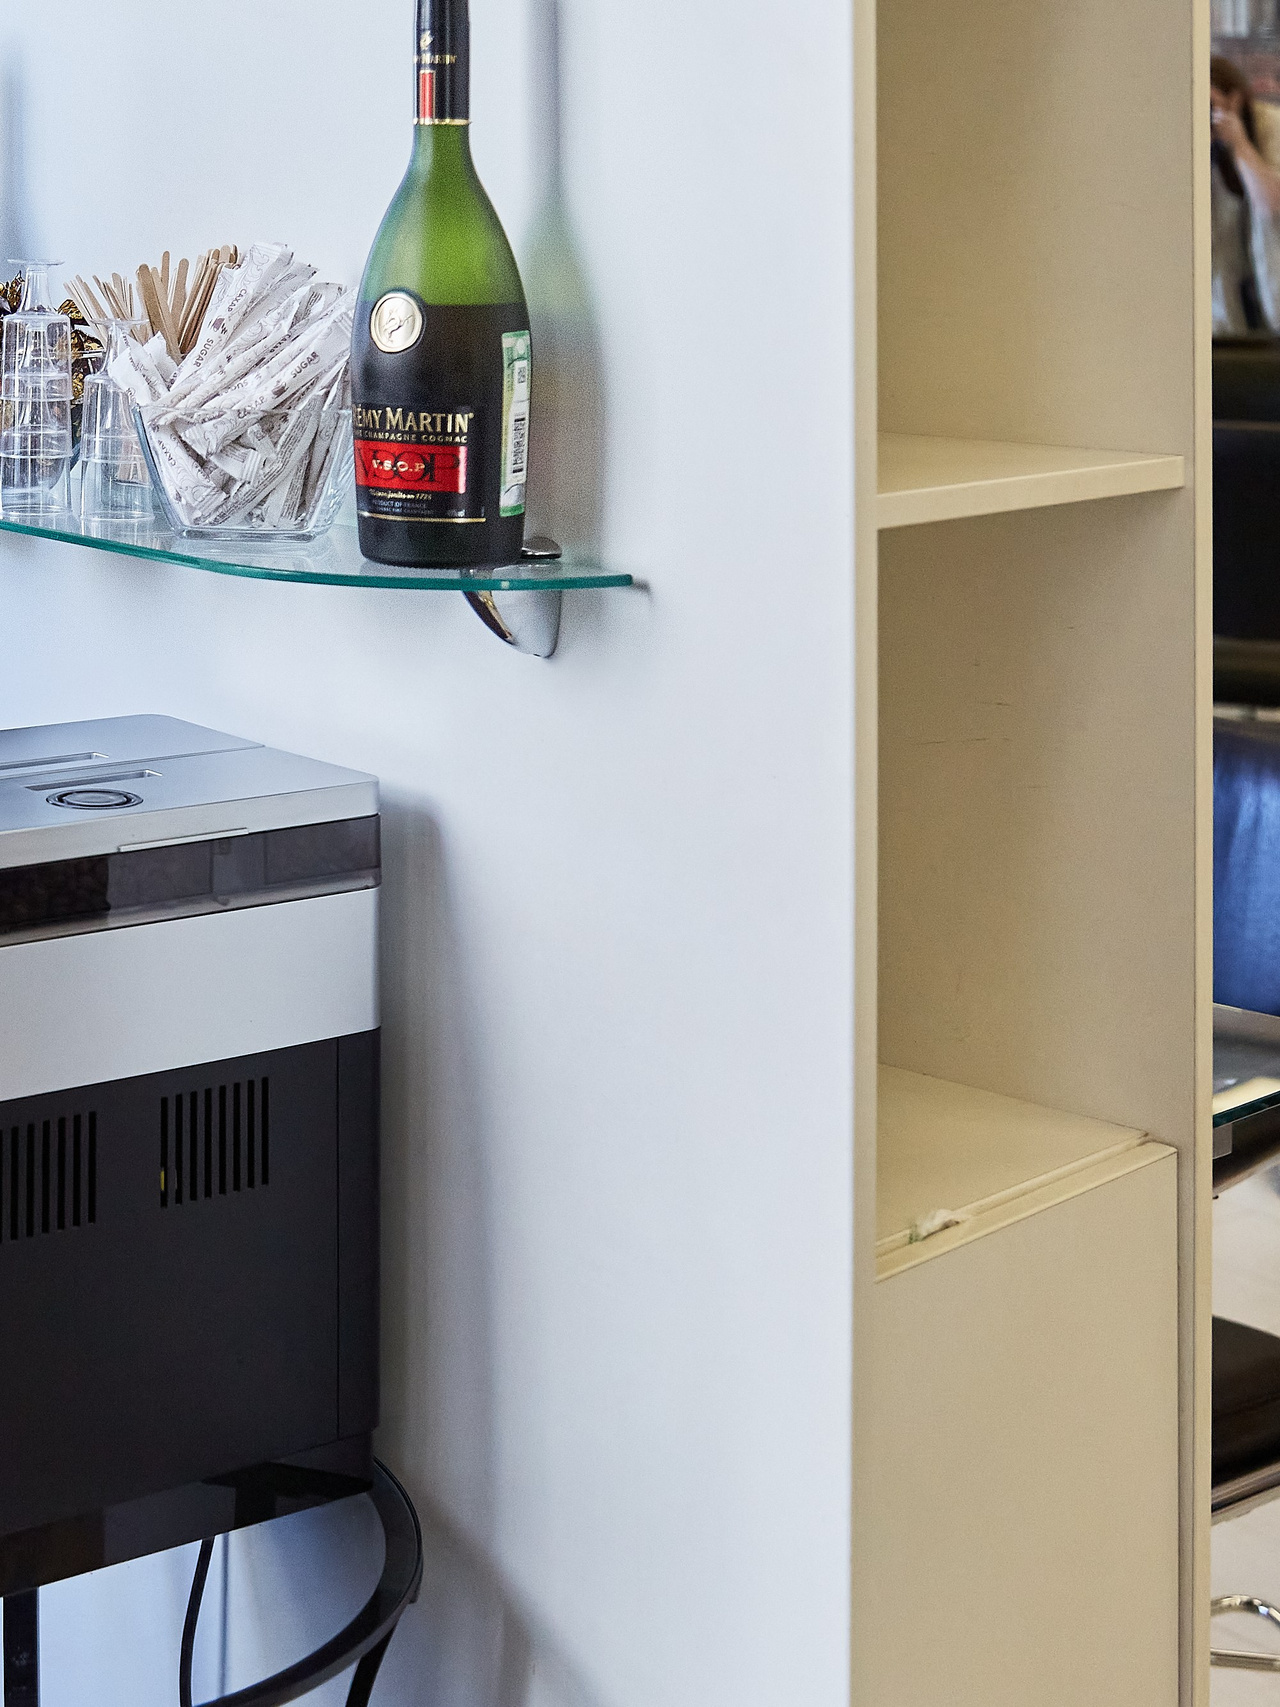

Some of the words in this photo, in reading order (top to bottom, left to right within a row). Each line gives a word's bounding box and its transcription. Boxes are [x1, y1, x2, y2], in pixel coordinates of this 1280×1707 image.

[193, 338, 214, 367] SUGAR
[291, 351, 319, 378] SUGAR
[385, 406, 469, 433] MARTIN
[422, 434, 468, 443] COGNAC
